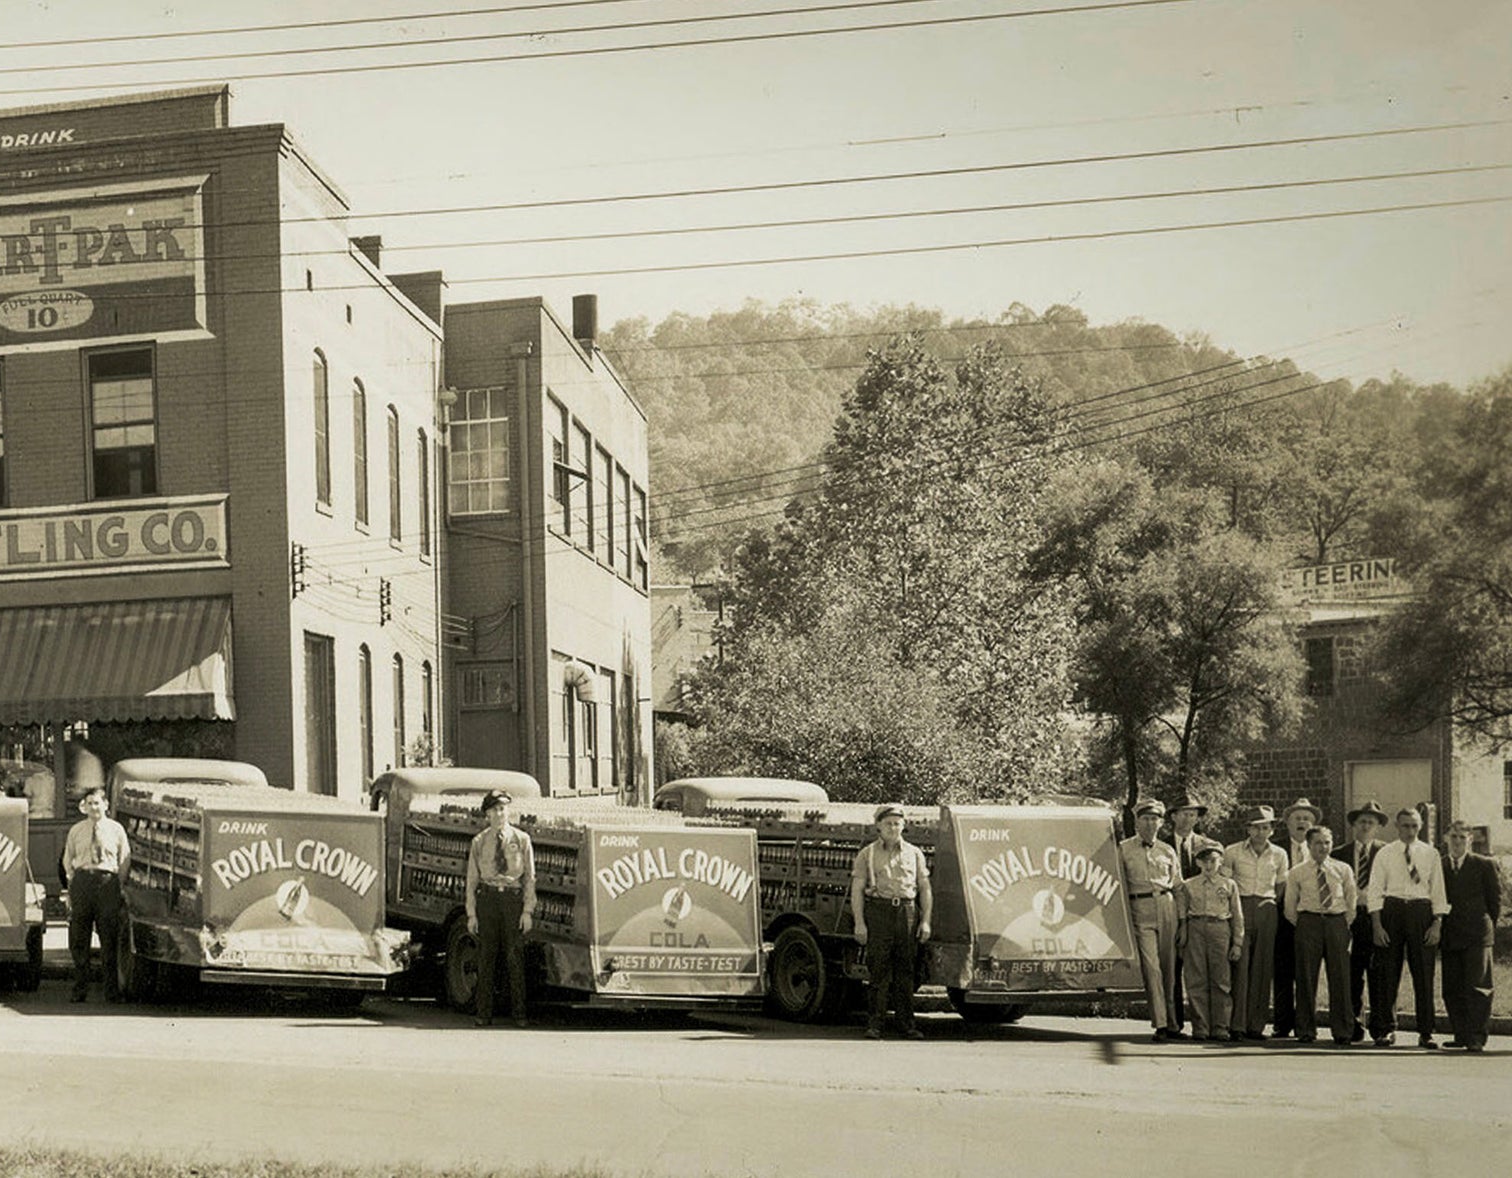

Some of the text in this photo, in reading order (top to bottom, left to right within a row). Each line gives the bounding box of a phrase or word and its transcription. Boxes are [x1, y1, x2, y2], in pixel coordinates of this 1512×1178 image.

[1, 129, 75, 148] DRINK
[40, 293, 80, 306] QUART
[140, 510, 218, 555] CO.
[1282, 561, 1397, 588] TEERIN
[219, 821, 268, 835] DRINK
[969, 829, 1010, 841] DRINK
[600, 835, 639, 847] DRINK
[211, 838, 379, 897] ROYAL CROWN
[597, 847, 754, 902] ROYAL CROWN
[970, 846, 1120, 906] ROYAL CROWN
[650, 932, 710, 948] COLA
[1032, 938, 1089, 955] COLA
[649, 956, 665, 969] BY
[1011, 962, 1040, 973] BEST
[1042, 962, 1057, 973] BY
